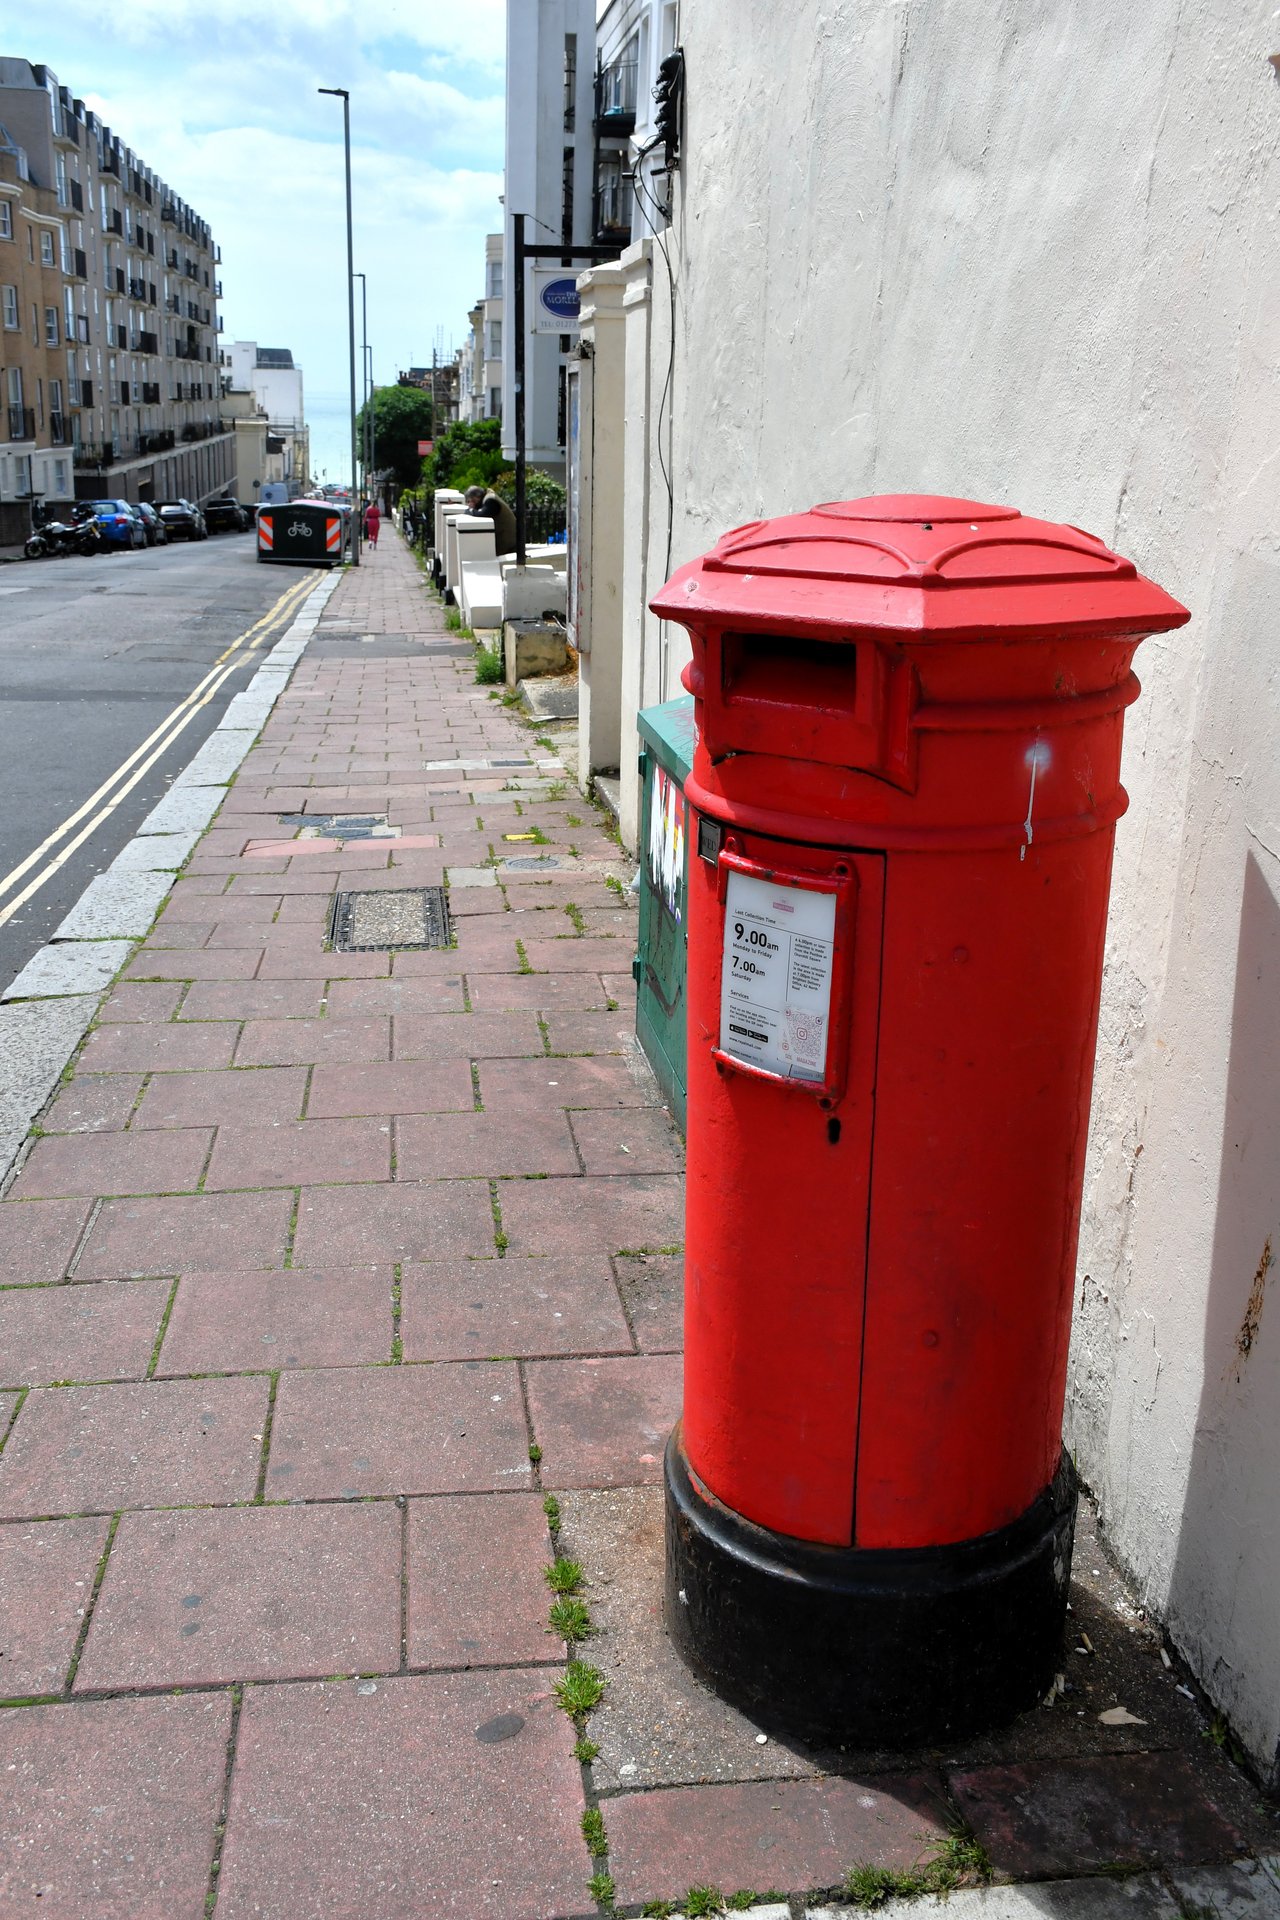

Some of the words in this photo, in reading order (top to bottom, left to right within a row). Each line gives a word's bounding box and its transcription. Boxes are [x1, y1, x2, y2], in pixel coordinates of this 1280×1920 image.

[745, 912, 764, 920] Collection
[734, 923, 778, 951] 9.00am
[732, 942, 750, 952] Monday
[758, 950, 772, 958] Friday
[732, 956, 765, 976] 7.00am
[732, 970, 752, 982] Saturday
[730, 990, 750, 1000] Services
